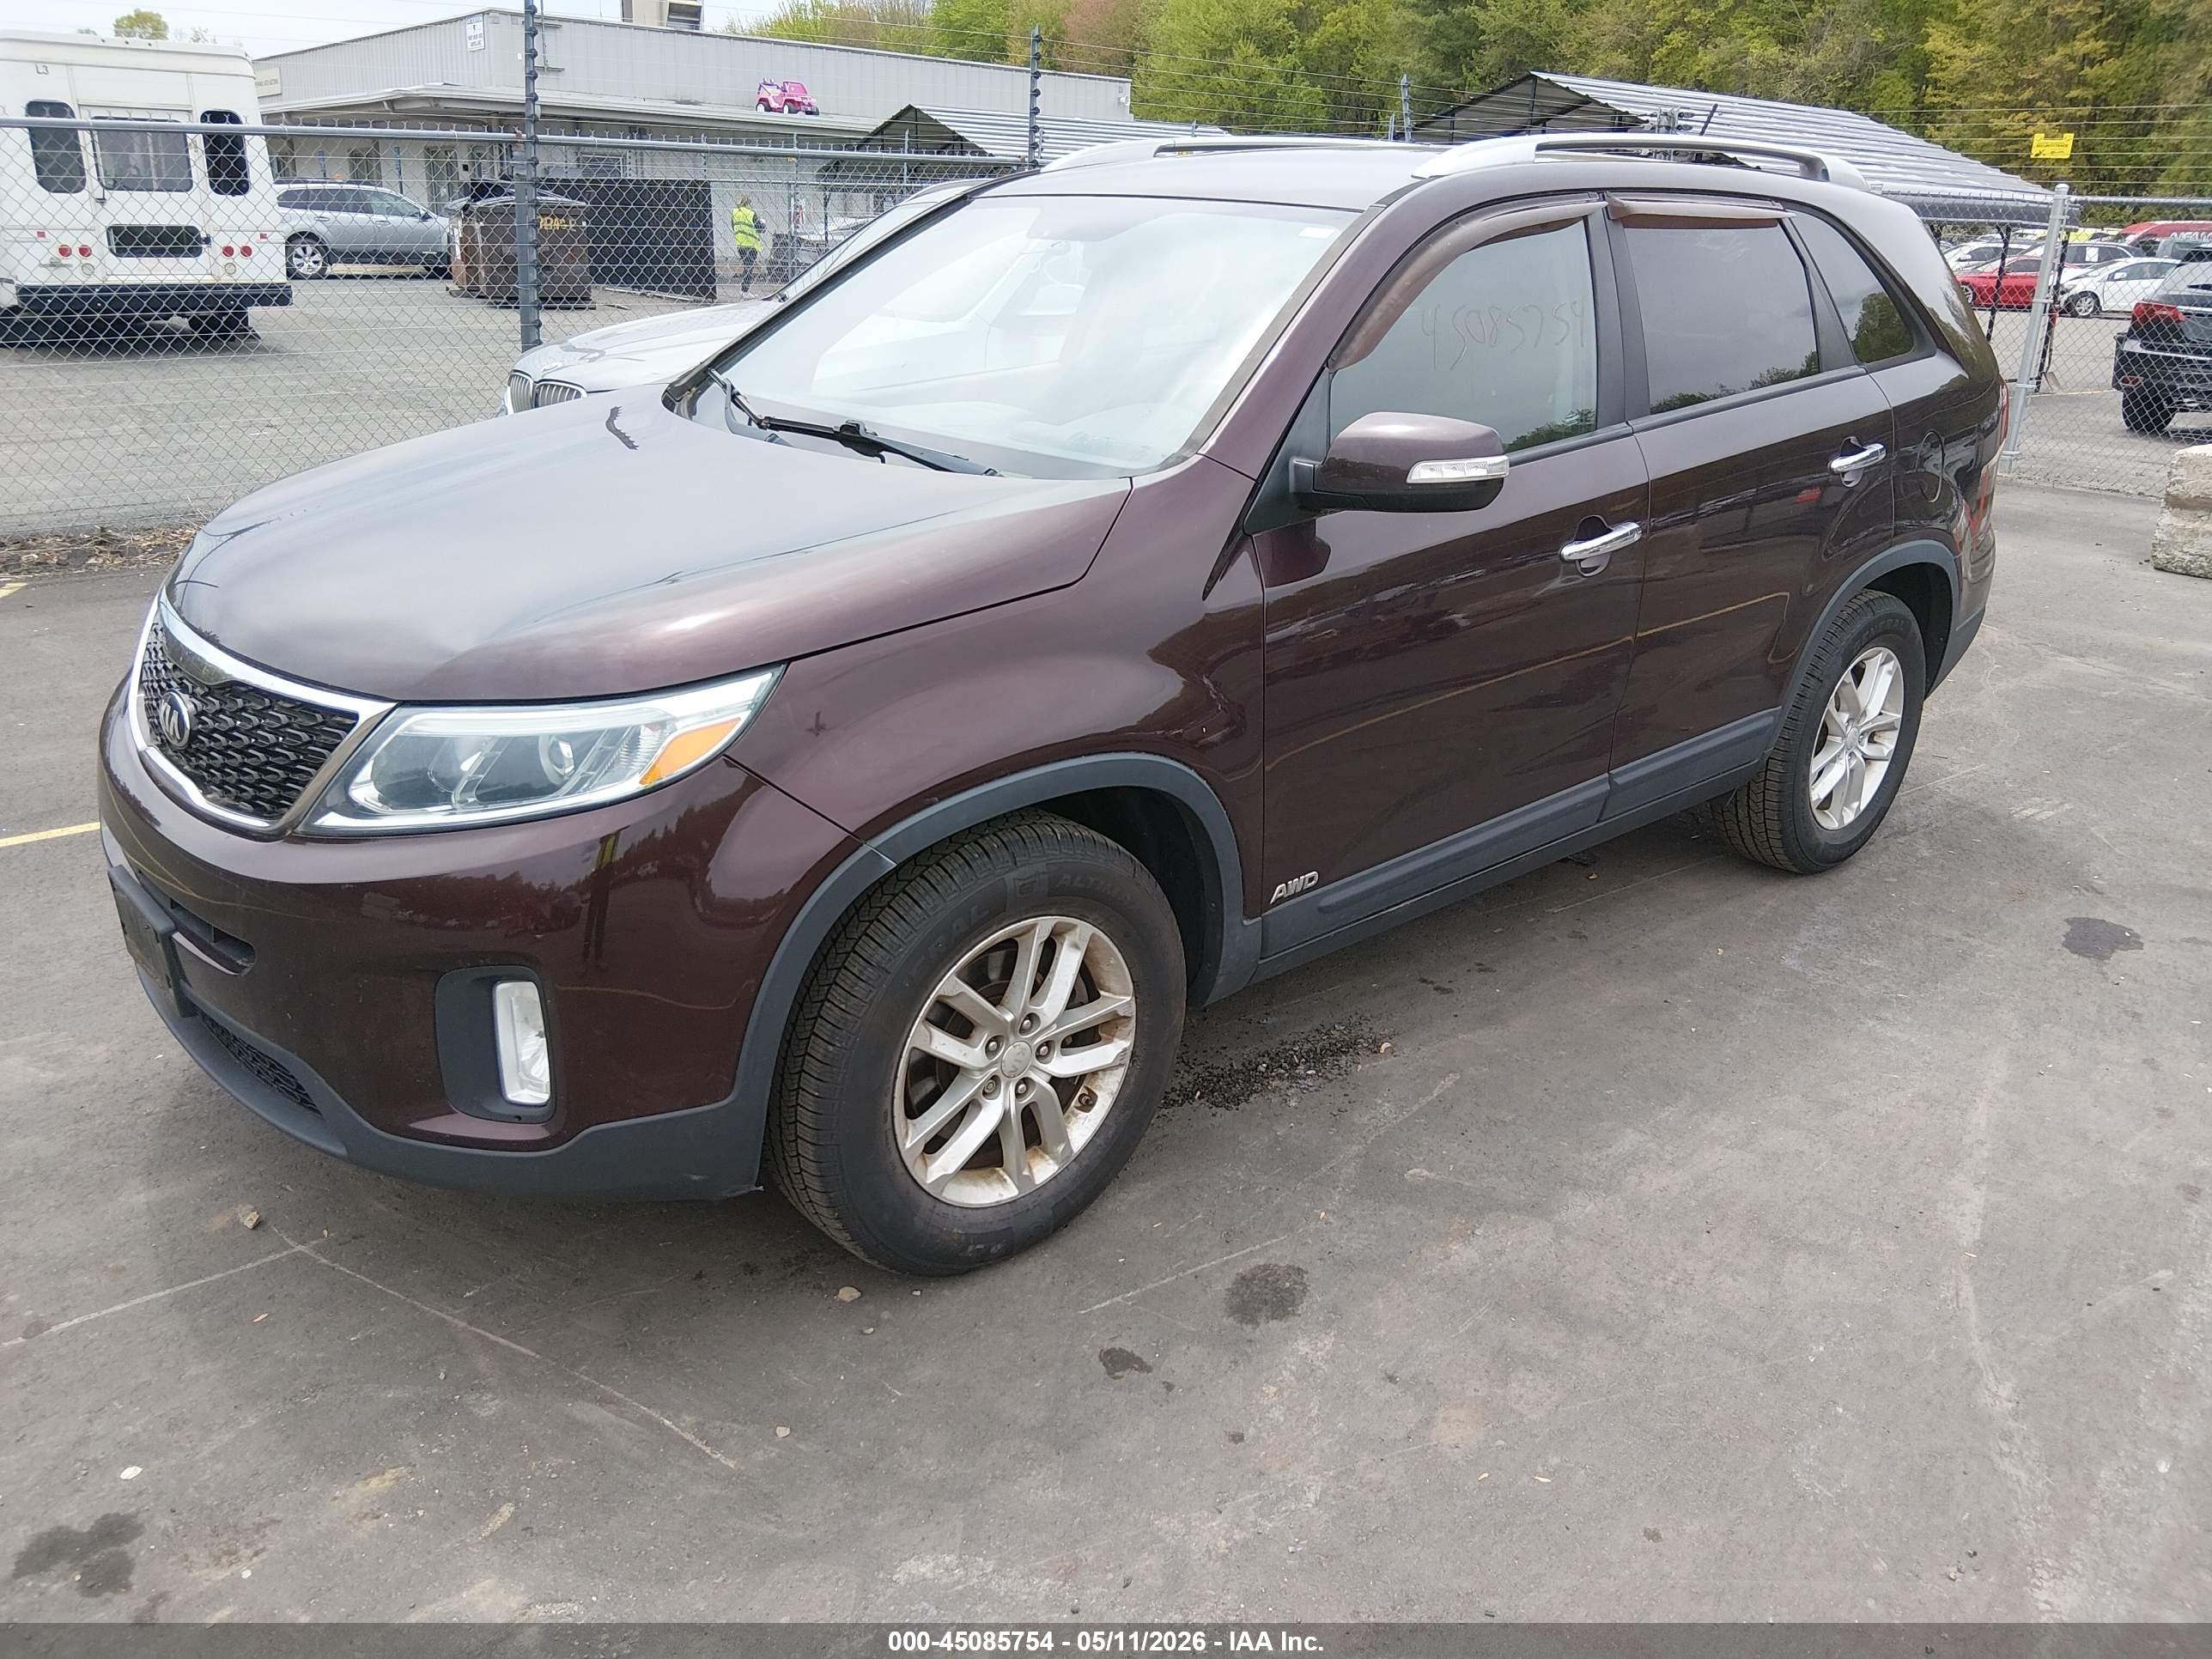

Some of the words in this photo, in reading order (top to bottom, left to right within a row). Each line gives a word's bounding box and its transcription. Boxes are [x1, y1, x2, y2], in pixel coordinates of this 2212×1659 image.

[35, 64, 49, 76] L3
[1421, 296, 1586, 371] 45085754
[1269, 871, 1319, 904] AWD
